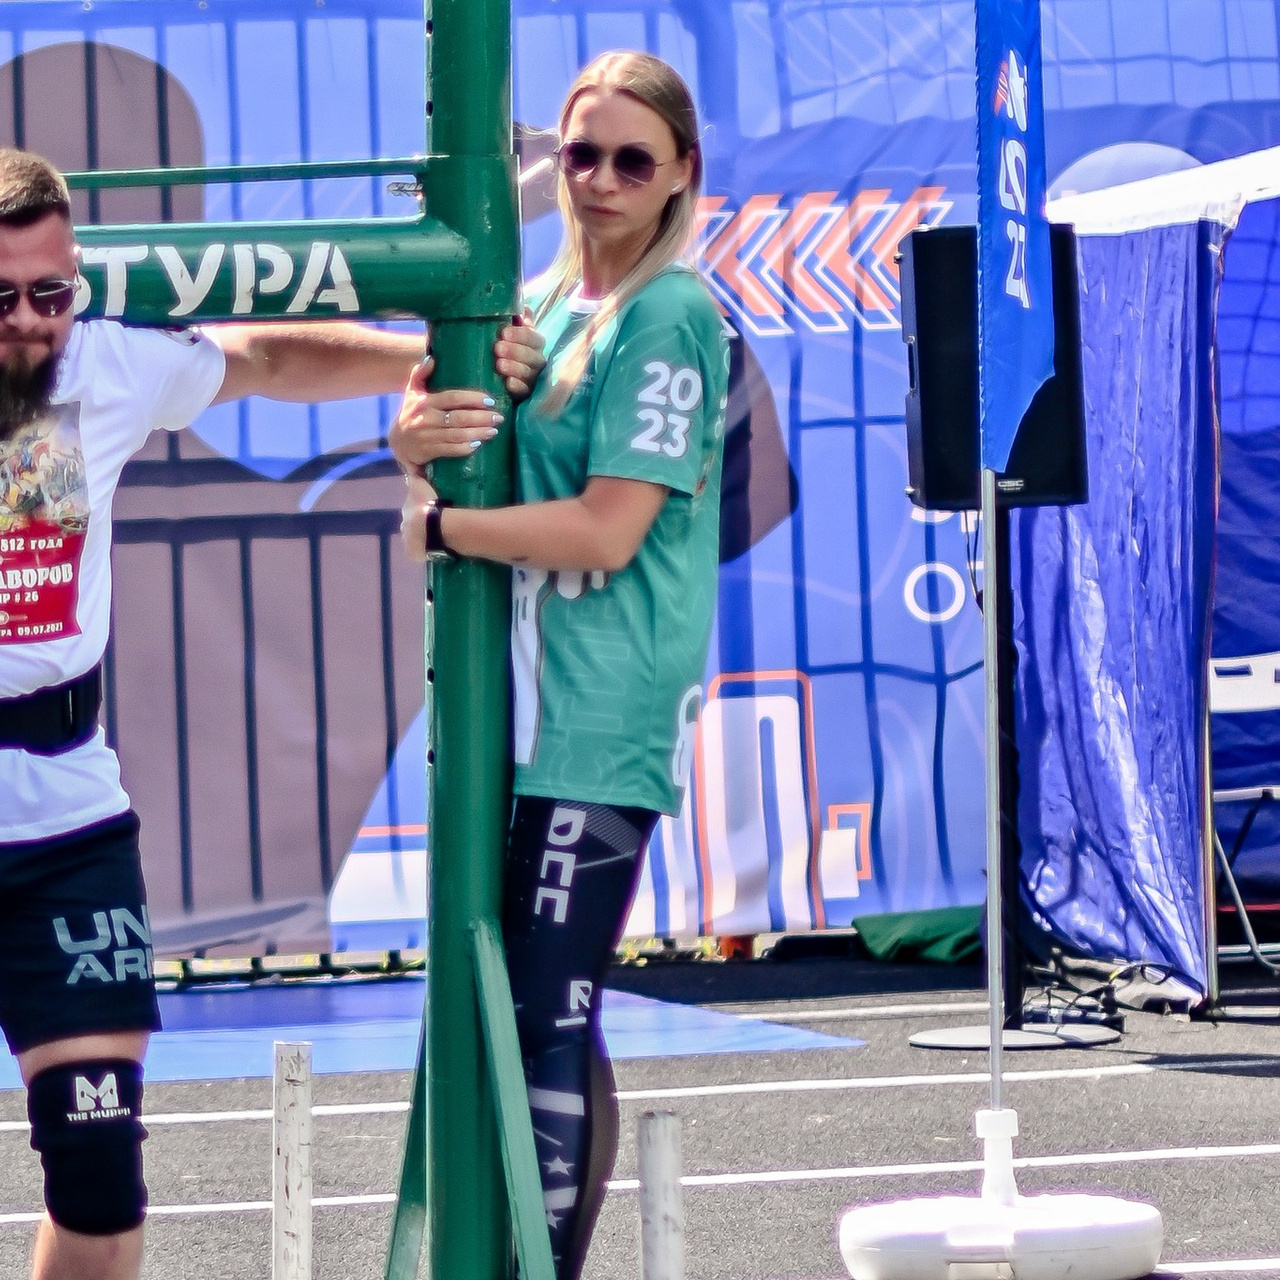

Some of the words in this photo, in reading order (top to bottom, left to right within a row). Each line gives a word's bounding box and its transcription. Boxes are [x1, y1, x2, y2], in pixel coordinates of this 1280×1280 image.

[638, 361, 703, 412] 20
[630, 408, 692, 458] 23
[24, 591, 39, 603] 26
[66, 947, 154, 985] AR
[66, 1112, 88, 1122] THE
[91, 1107, 131, 1120] MURPH
